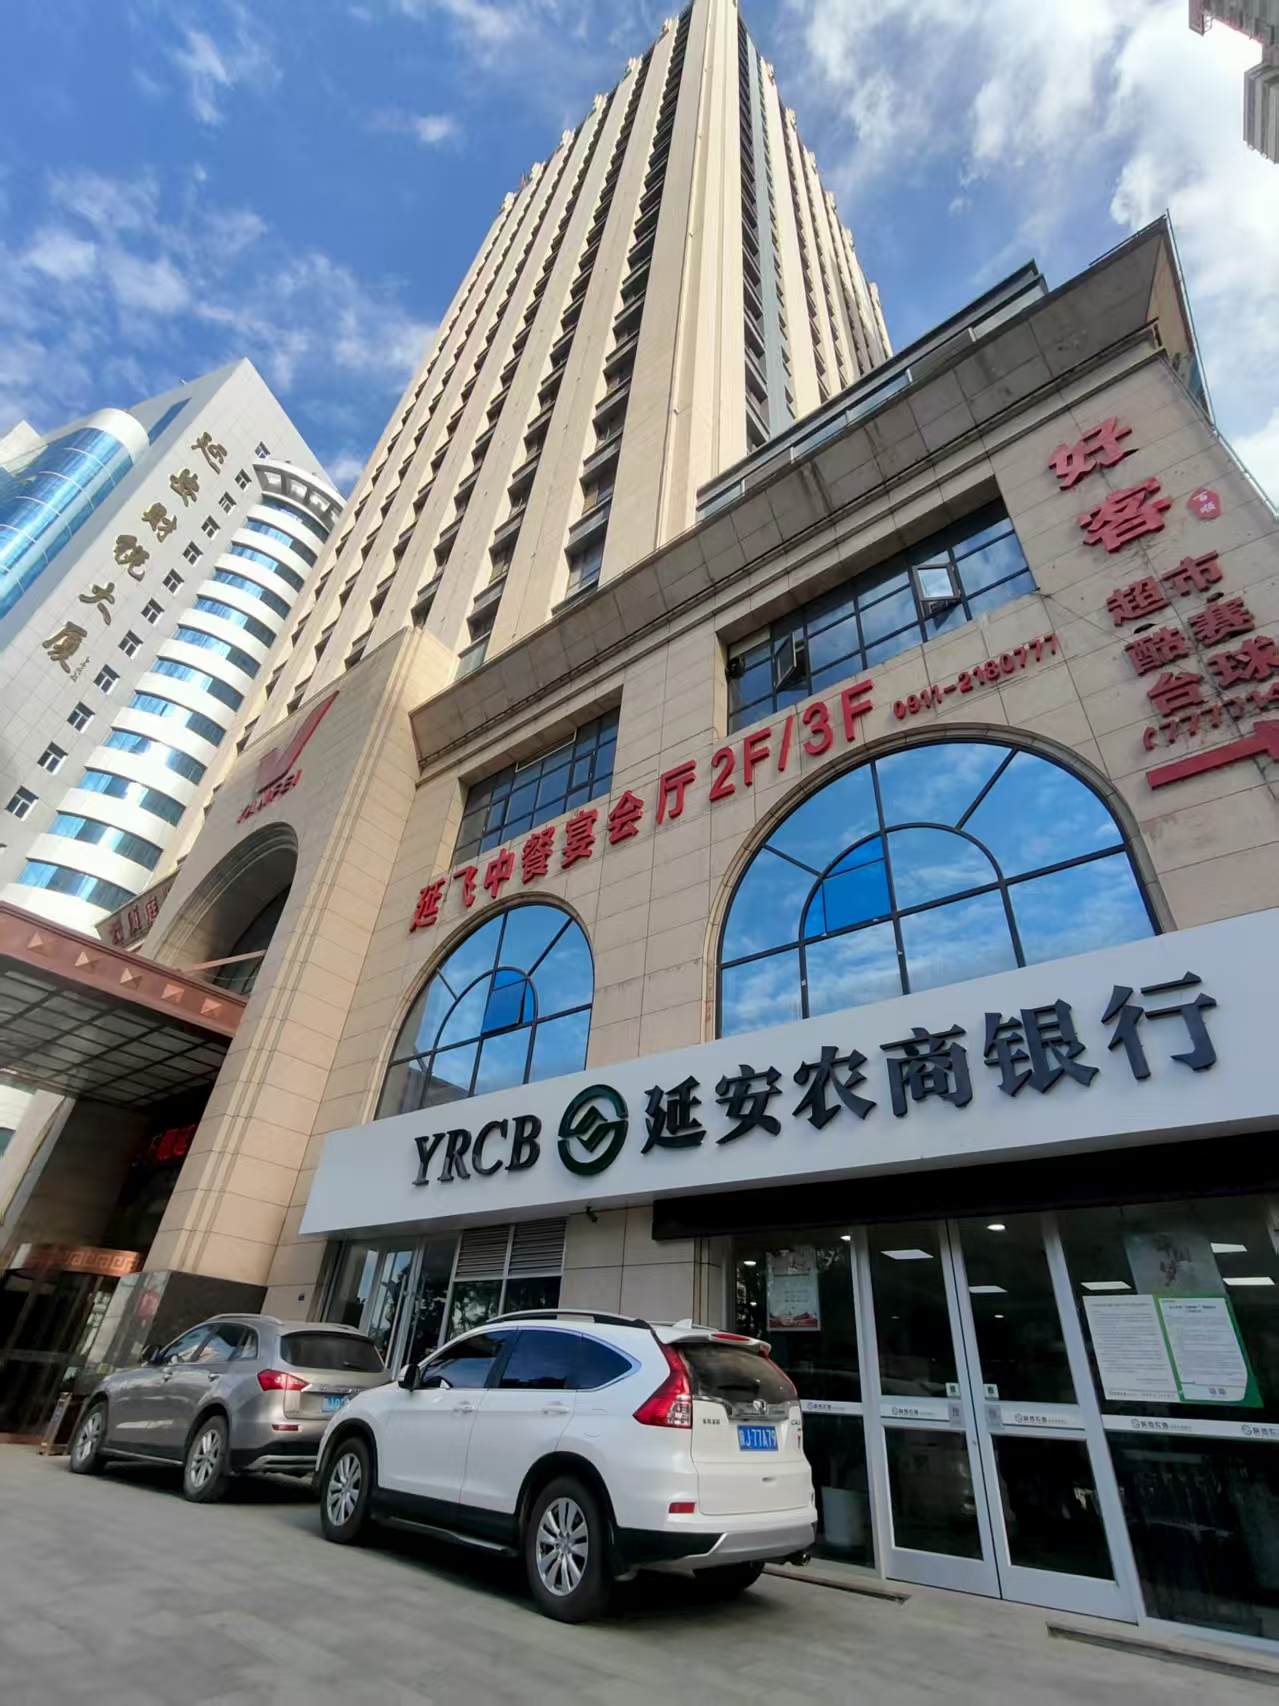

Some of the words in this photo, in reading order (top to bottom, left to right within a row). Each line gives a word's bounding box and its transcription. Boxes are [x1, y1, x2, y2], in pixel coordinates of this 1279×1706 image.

[1048, 416, 1174, 554] 好客
[1106, 549, 1224, 627] 超市
[1124, 596, 1256, 677] 酷赛
[1146, 635, 1279, 716] 台球
[409, 759, 698, 934] 延飞中餐宴会厅
[708, 679, 876, 803] 2F/3F
[893, 631, 1059, 720] 0911-2180777
[411, 1115, 543, 1187] YRCB
[640, 971, 1218, 1156] 延安农商银行
